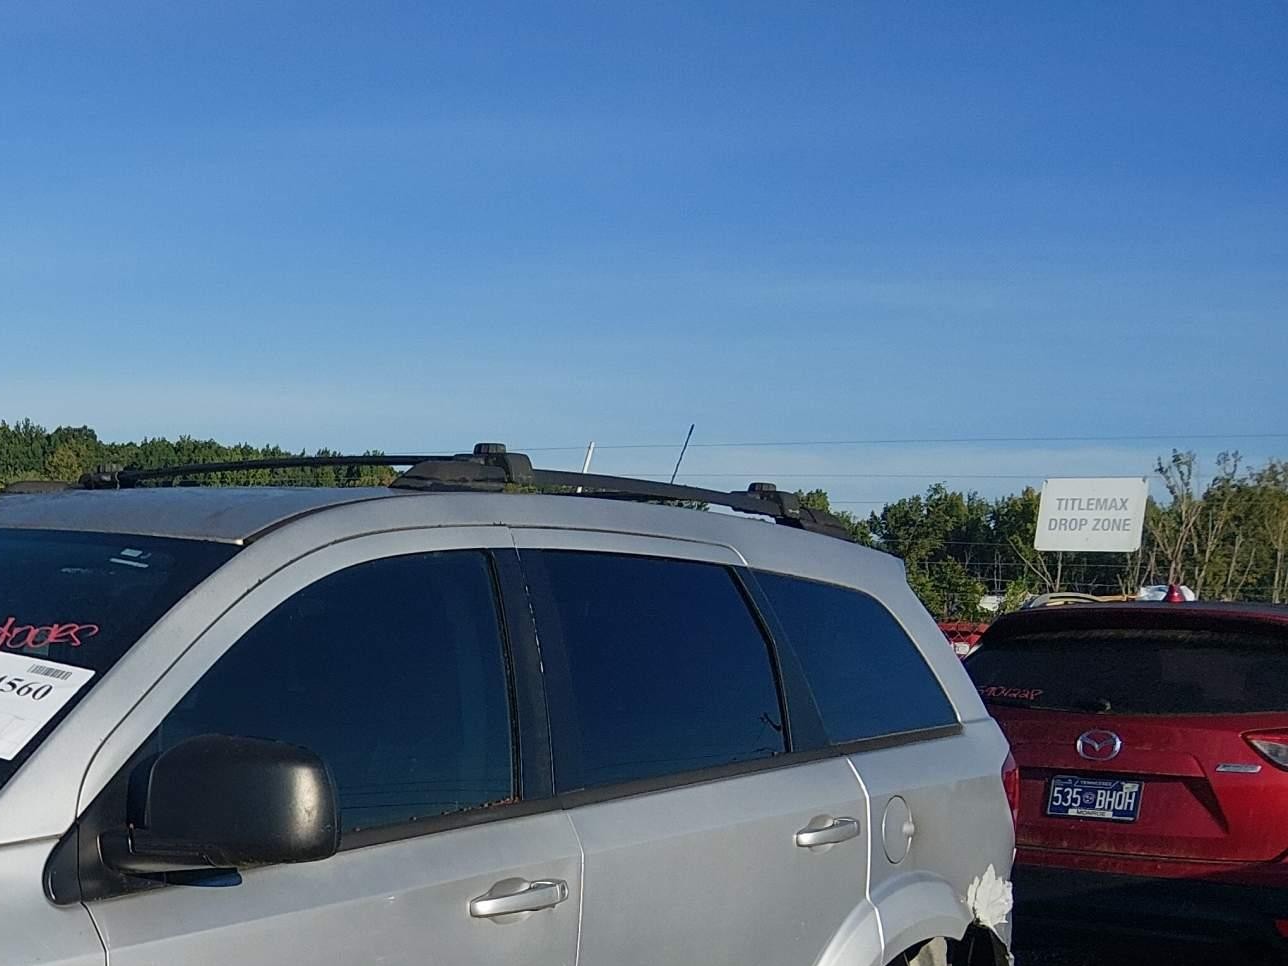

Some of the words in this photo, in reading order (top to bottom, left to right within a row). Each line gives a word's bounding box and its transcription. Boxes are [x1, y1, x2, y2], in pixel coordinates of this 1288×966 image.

[1055, 497, 1129, 511] TITLEMAX
[1047, 518, 1088, 532] DROP
[1091, 518, 1132, 532] ZONE
[1052, 786, 1083, 807] 535
